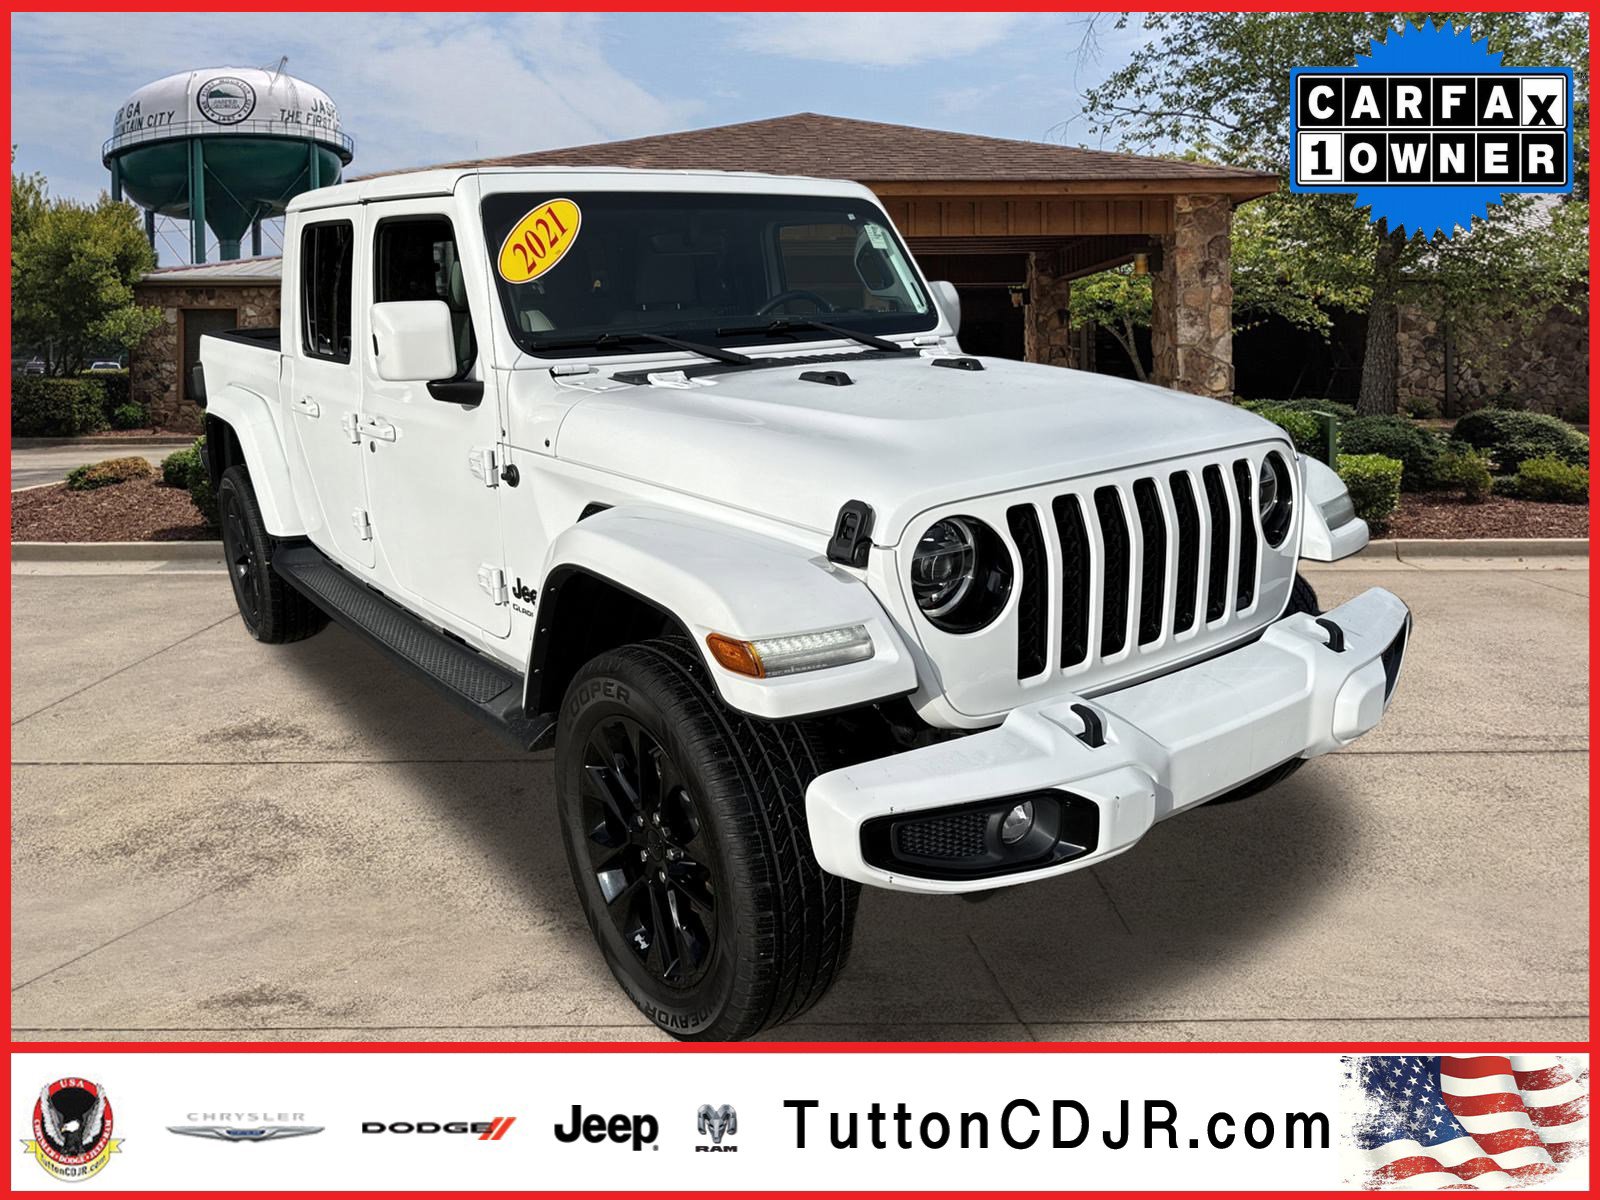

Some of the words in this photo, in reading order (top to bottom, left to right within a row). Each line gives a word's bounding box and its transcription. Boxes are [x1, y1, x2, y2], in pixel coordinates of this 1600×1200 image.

[126, 101, 140, 118] GA
[280, 108, 302, 124] THE
[147, 110, 175, 127] CITY
[512, 206, 568, 274] 2021
